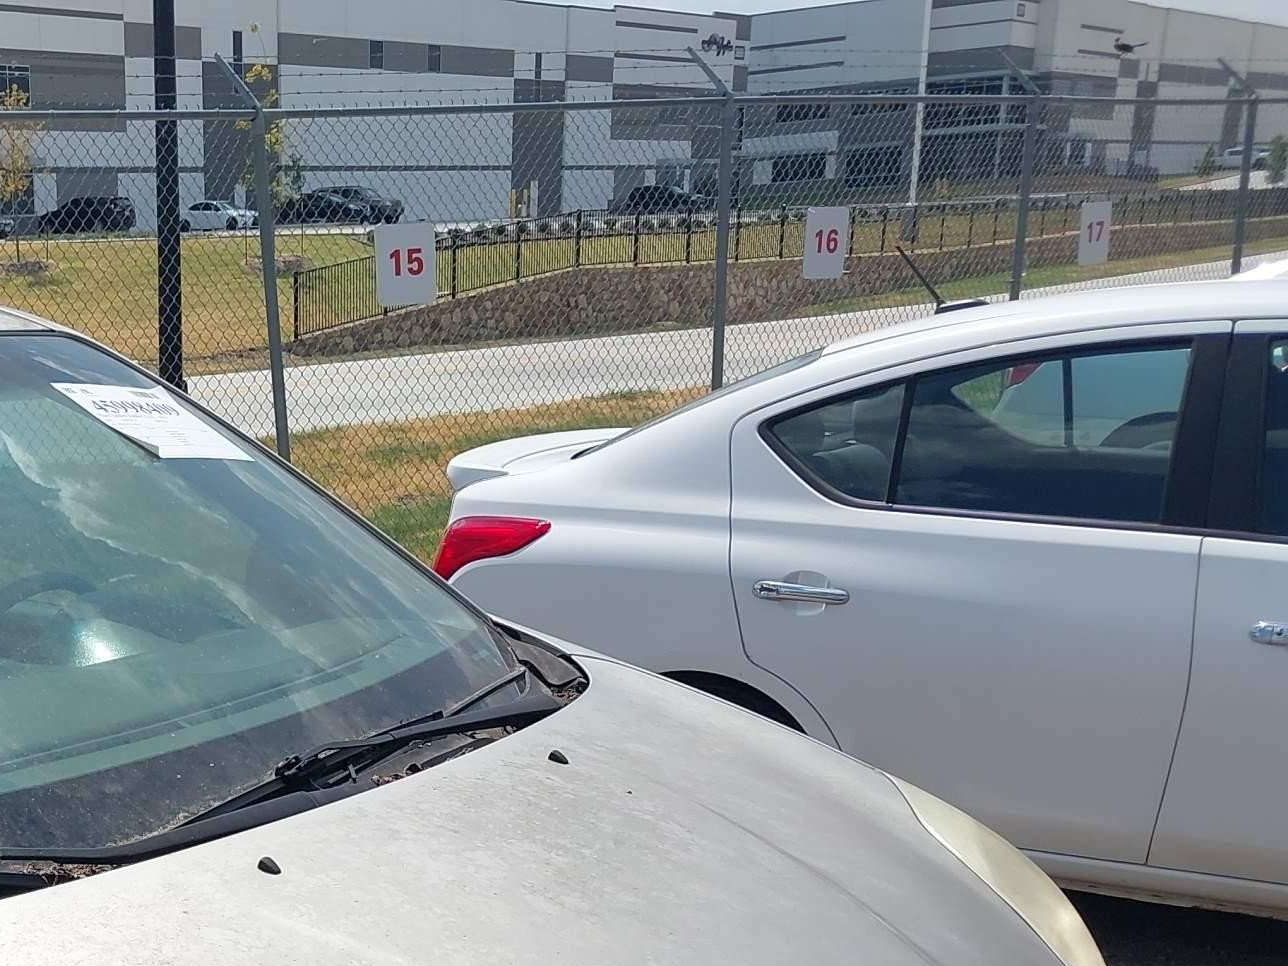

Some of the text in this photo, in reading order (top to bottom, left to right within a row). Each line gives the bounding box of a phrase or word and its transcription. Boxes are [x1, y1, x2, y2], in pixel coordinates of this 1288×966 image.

[815, 229, 839, 254] 16
[1087, 221, 1105, 243] 17
[389, 247, 424, 277] 15
[90, 399, 181, 417] 45998409
